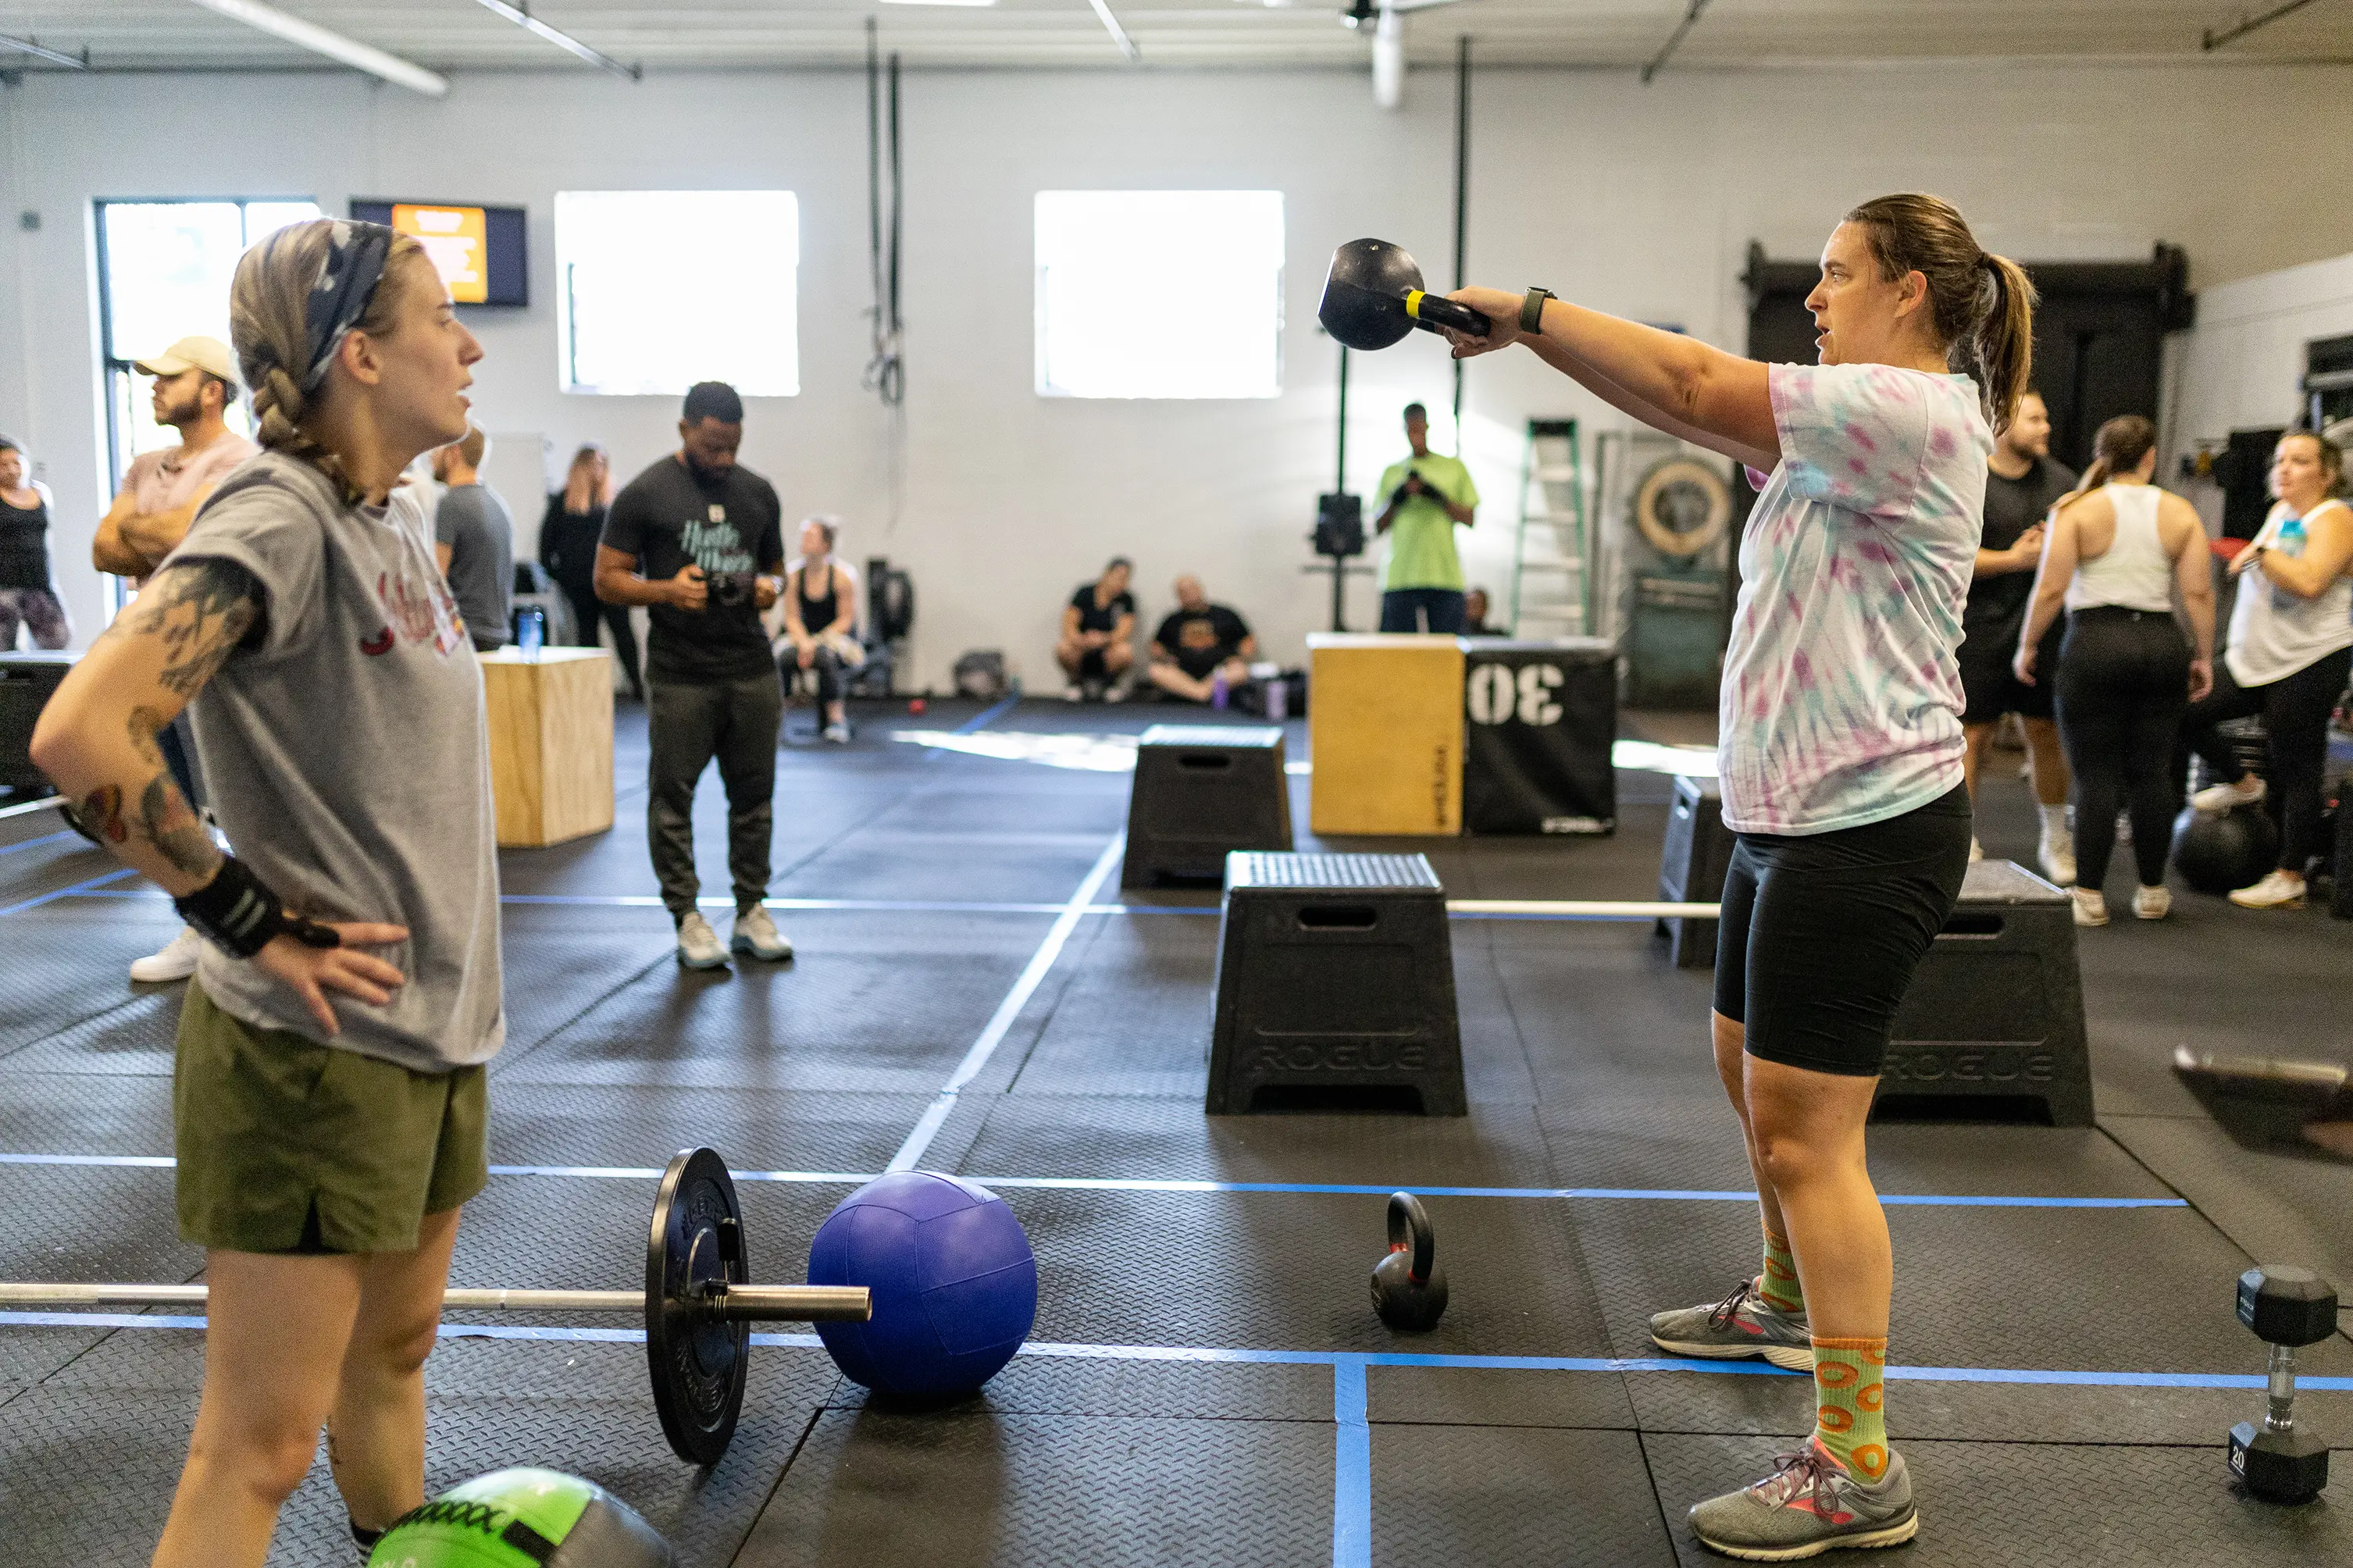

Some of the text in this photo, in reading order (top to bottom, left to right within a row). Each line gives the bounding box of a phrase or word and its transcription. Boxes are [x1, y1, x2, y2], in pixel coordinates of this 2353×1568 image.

[1253, 1043, 1426, 1071] ROGUE
[1879, 1054, 2054, 1082] ROGUE
[2232, 1445, 2244, 1470] 20
